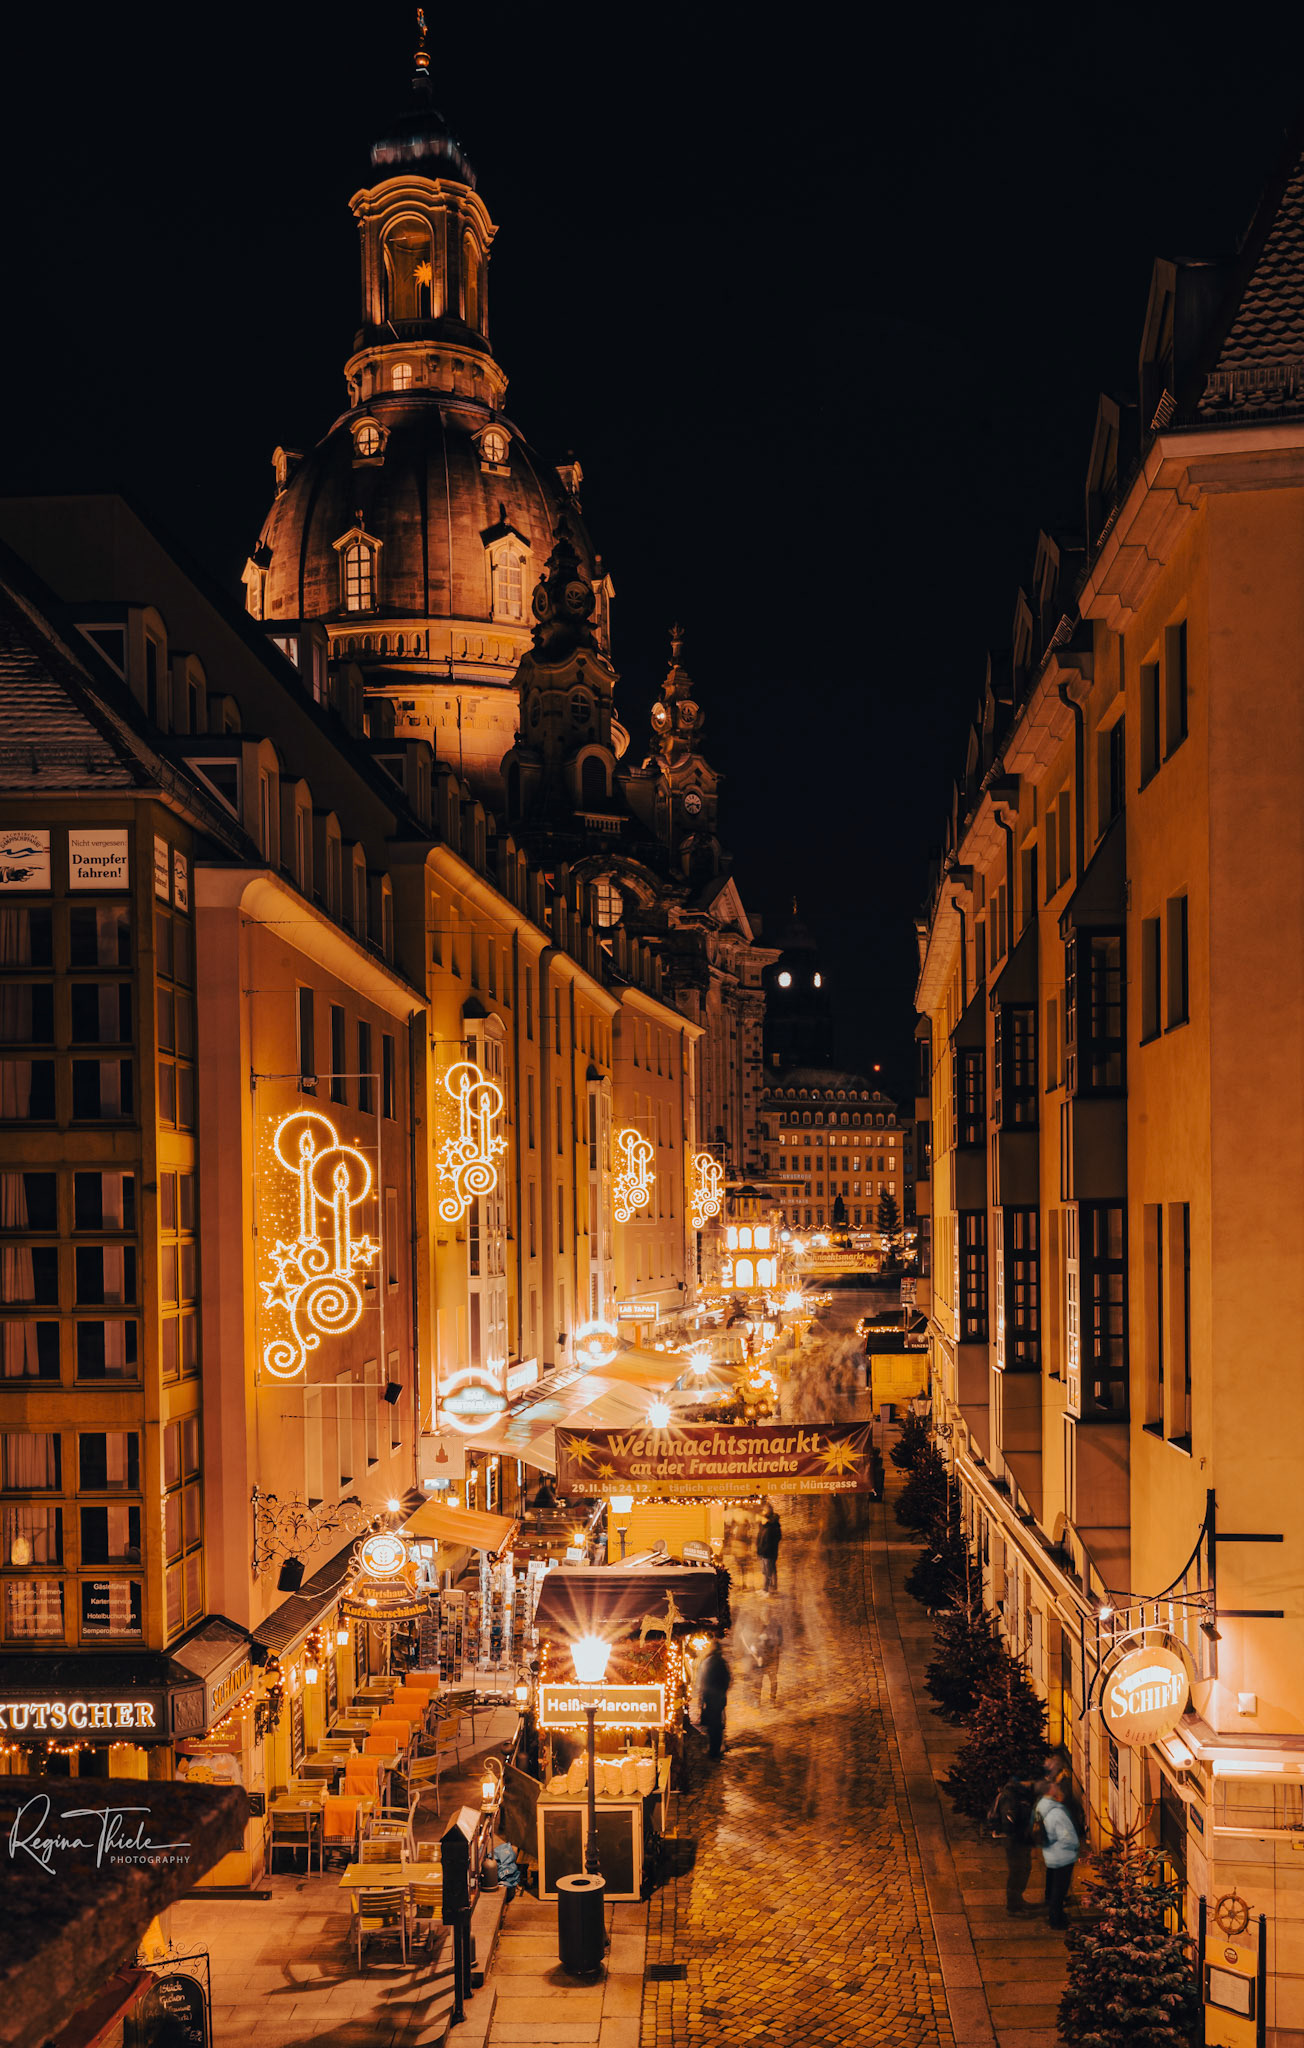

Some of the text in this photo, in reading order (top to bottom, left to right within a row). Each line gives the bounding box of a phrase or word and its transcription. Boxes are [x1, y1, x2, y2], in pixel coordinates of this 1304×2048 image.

[72, 854, 127, 866] Dampfer
[78, 868, 122, 878] fahren!
[607, 1430, 820, 1457] Weihnachtsmarkt
[630, 1456, 798, 1475] an der Frauenkirche
[669, 1483, 704, 1494] täglich
[706, 1482, 750, 1493] geöffnet
[767, 1482, 777, 1490] in
[780, 1481, 797, 1490] der
[800, 1480, 857, 1490] Münzgasse
[362, 1588, 408, 1599] Wirtshaus
[342, 1602, 428, 1618] Kutscherschänke
[1111, 1673, 1184, 1718] SCHIFF
[594, 1699, 657, 1712] Maronen
